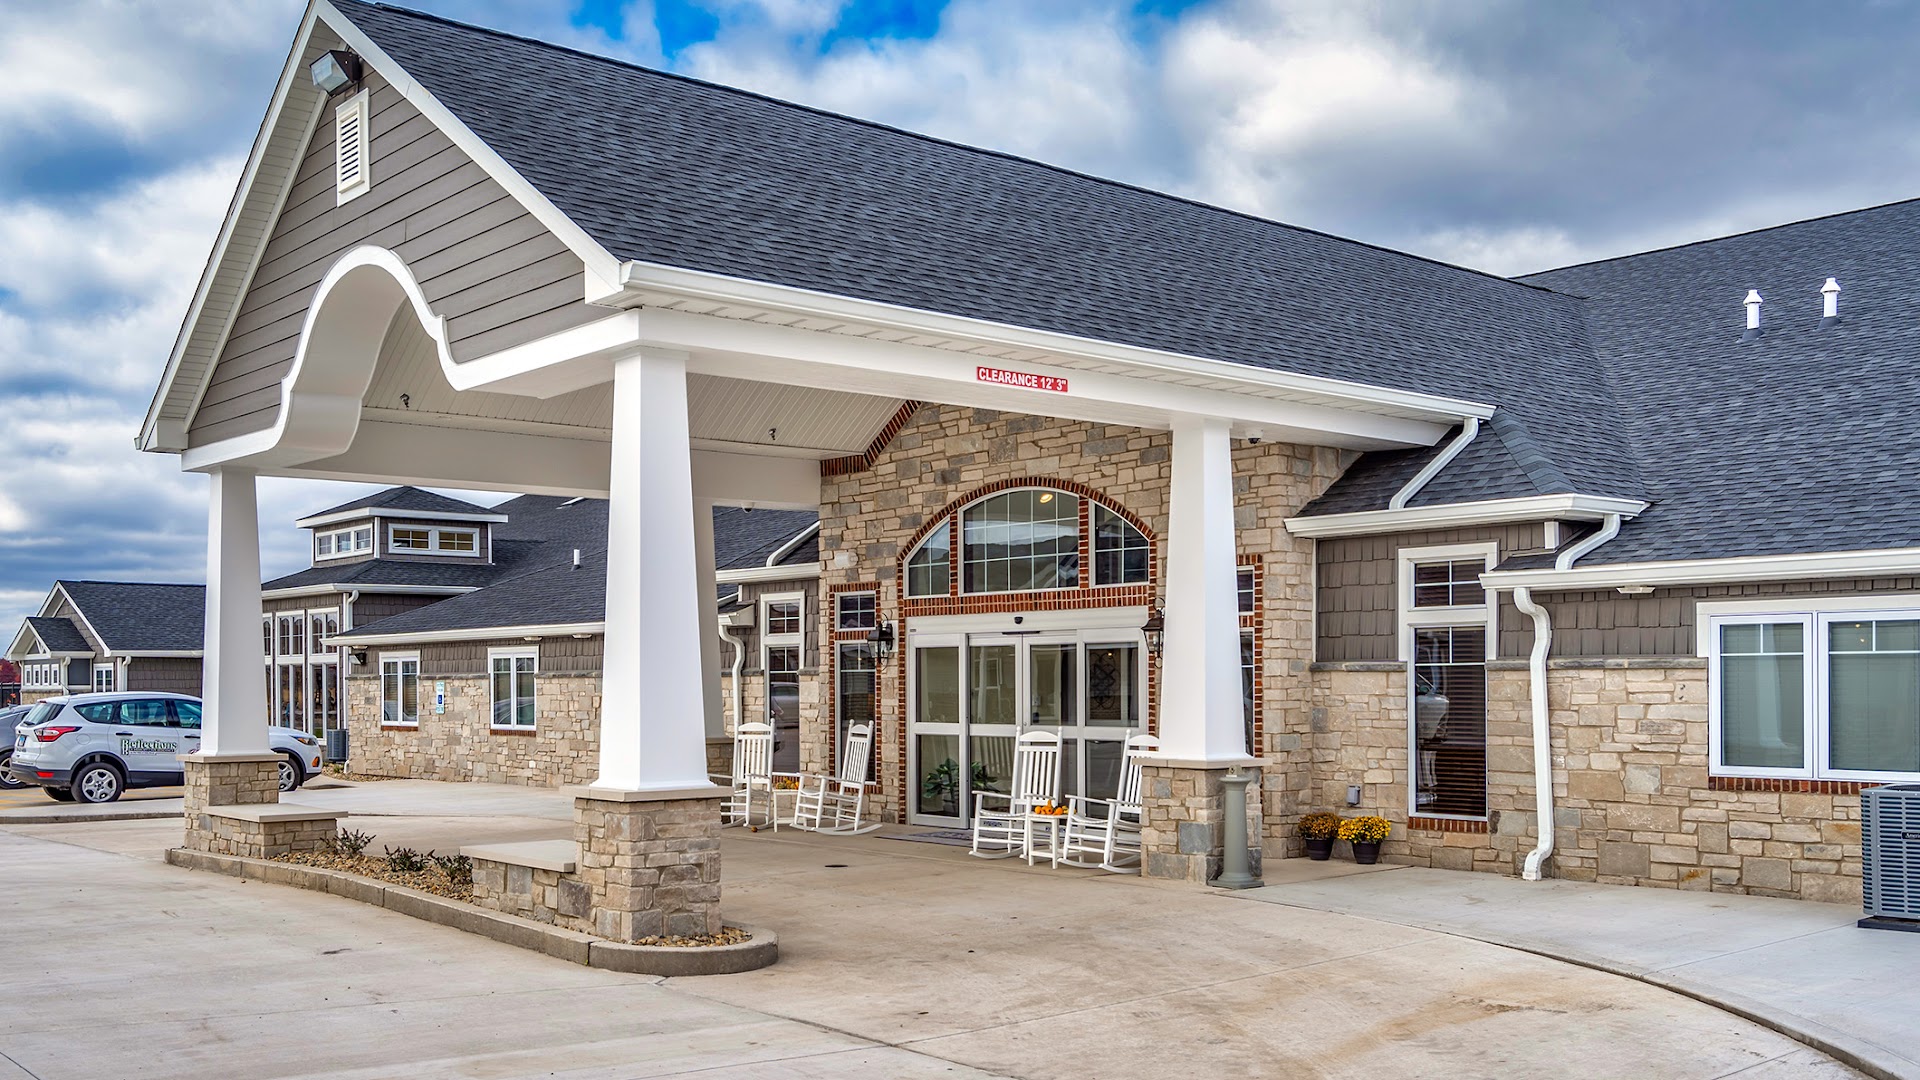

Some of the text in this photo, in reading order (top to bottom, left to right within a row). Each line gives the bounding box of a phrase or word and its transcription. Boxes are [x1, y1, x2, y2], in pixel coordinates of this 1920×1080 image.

[979, 368, 1067, 391] CLEARANCE 12' 3"
[121, 739, 177, 755] Reflections
